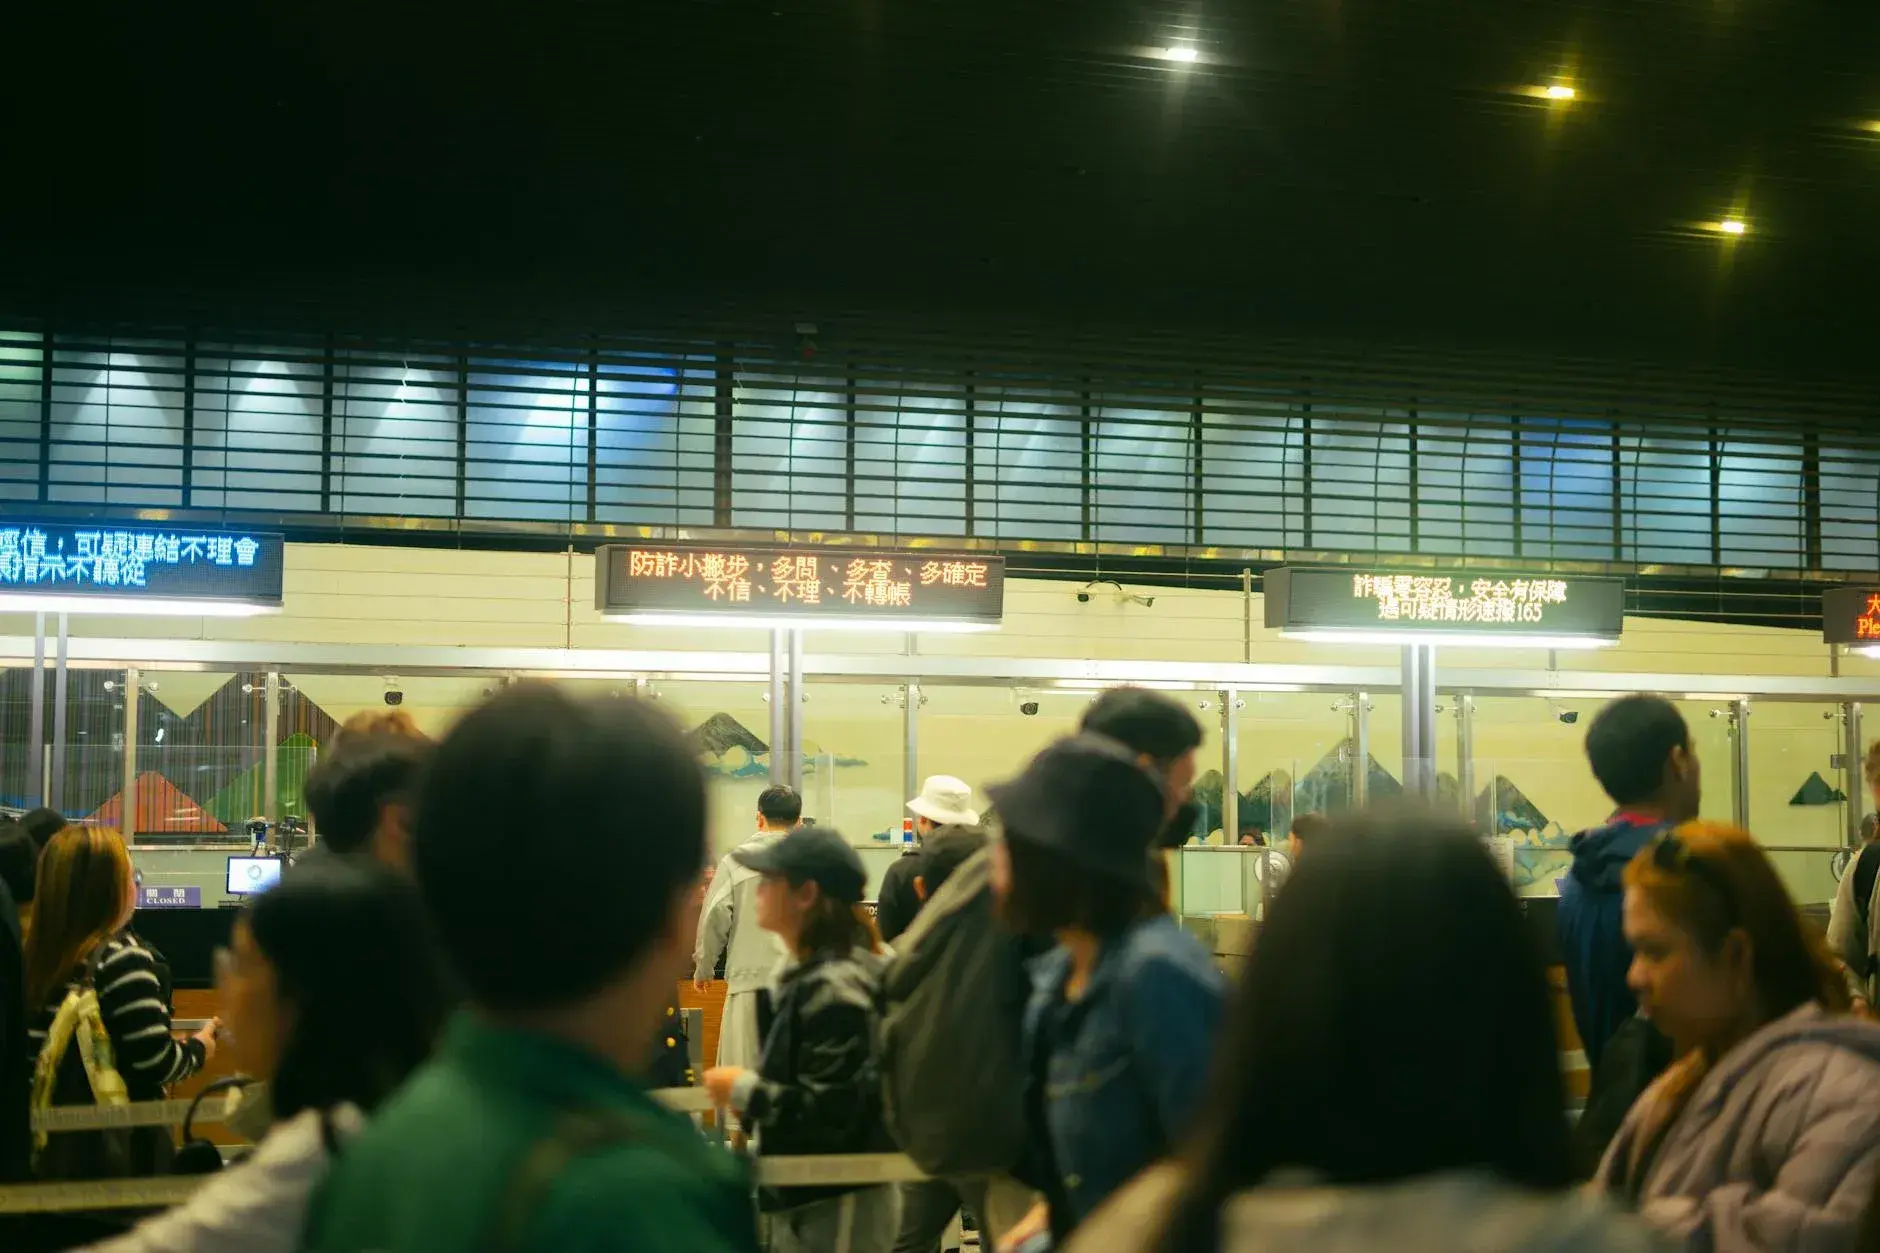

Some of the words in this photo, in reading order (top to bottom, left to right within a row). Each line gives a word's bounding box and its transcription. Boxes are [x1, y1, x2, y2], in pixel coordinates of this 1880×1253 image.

[703, 578, 912, 605] 不信、不理、不轉帳
